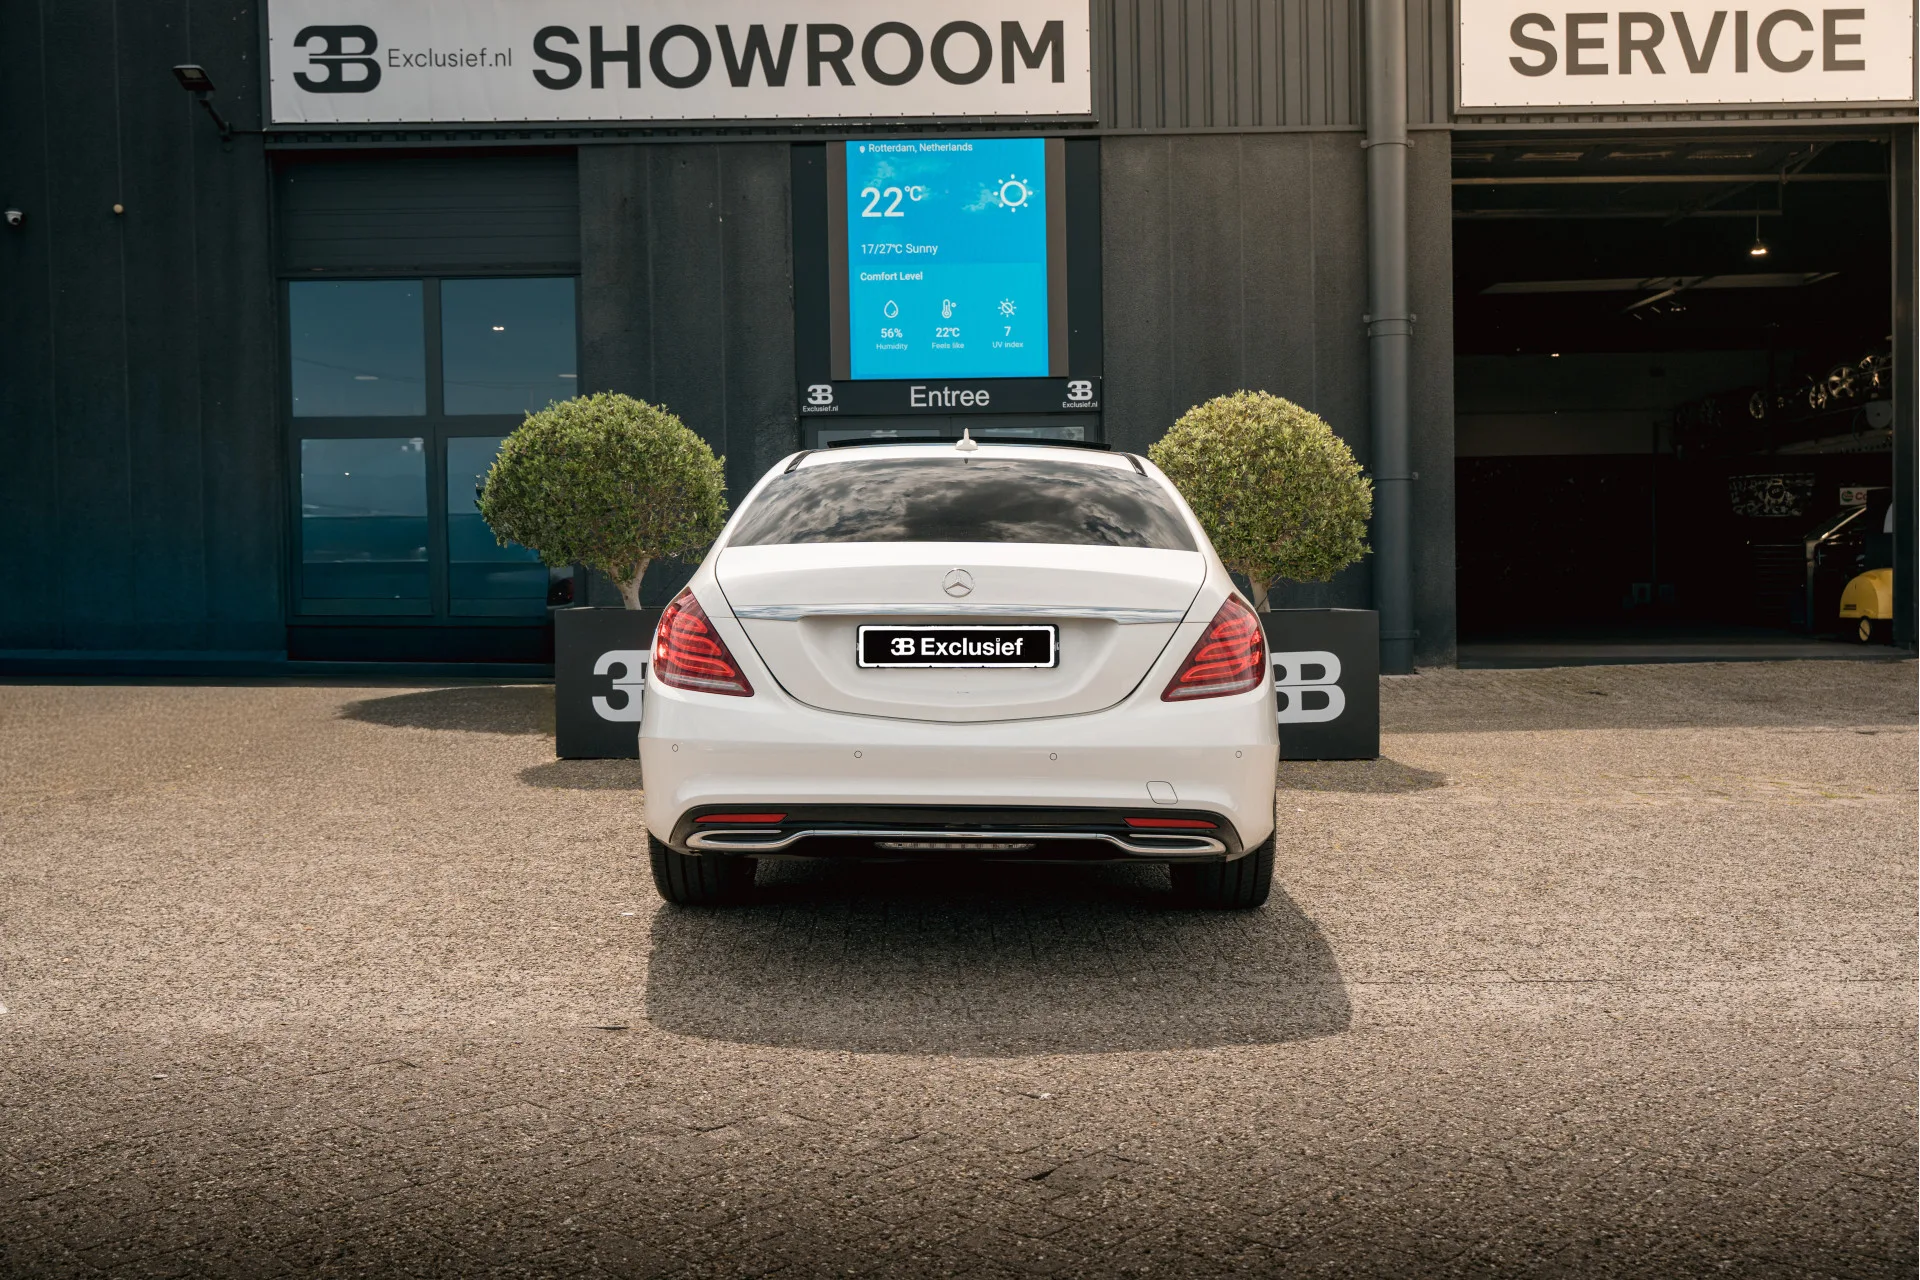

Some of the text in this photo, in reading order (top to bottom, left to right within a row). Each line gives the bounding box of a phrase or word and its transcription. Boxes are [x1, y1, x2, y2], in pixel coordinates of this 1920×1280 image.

[1509, 8, 1866, 77] SERVICE
[388, 47, 512, 67] Exclusief.nl
[532, 20, 1065, 91] SHOWROOM
[868, 142, 973, 153] Rotterdam, Netherlands
[905, 243, 938, 255] Sunny
[860, 271, 923, 281] Comfort Level
[880, 328, 903, 338] 56%
[935, 327, 960, 338] 22°C
[1004, 326, 1011, 337] 7
[876, 343, 908, 351] Humidity
[992, 341, 1003, 349] UV
[910, 385, 990, 408] Entree
[890, 637, 1024, 656] 3B Exclusief
